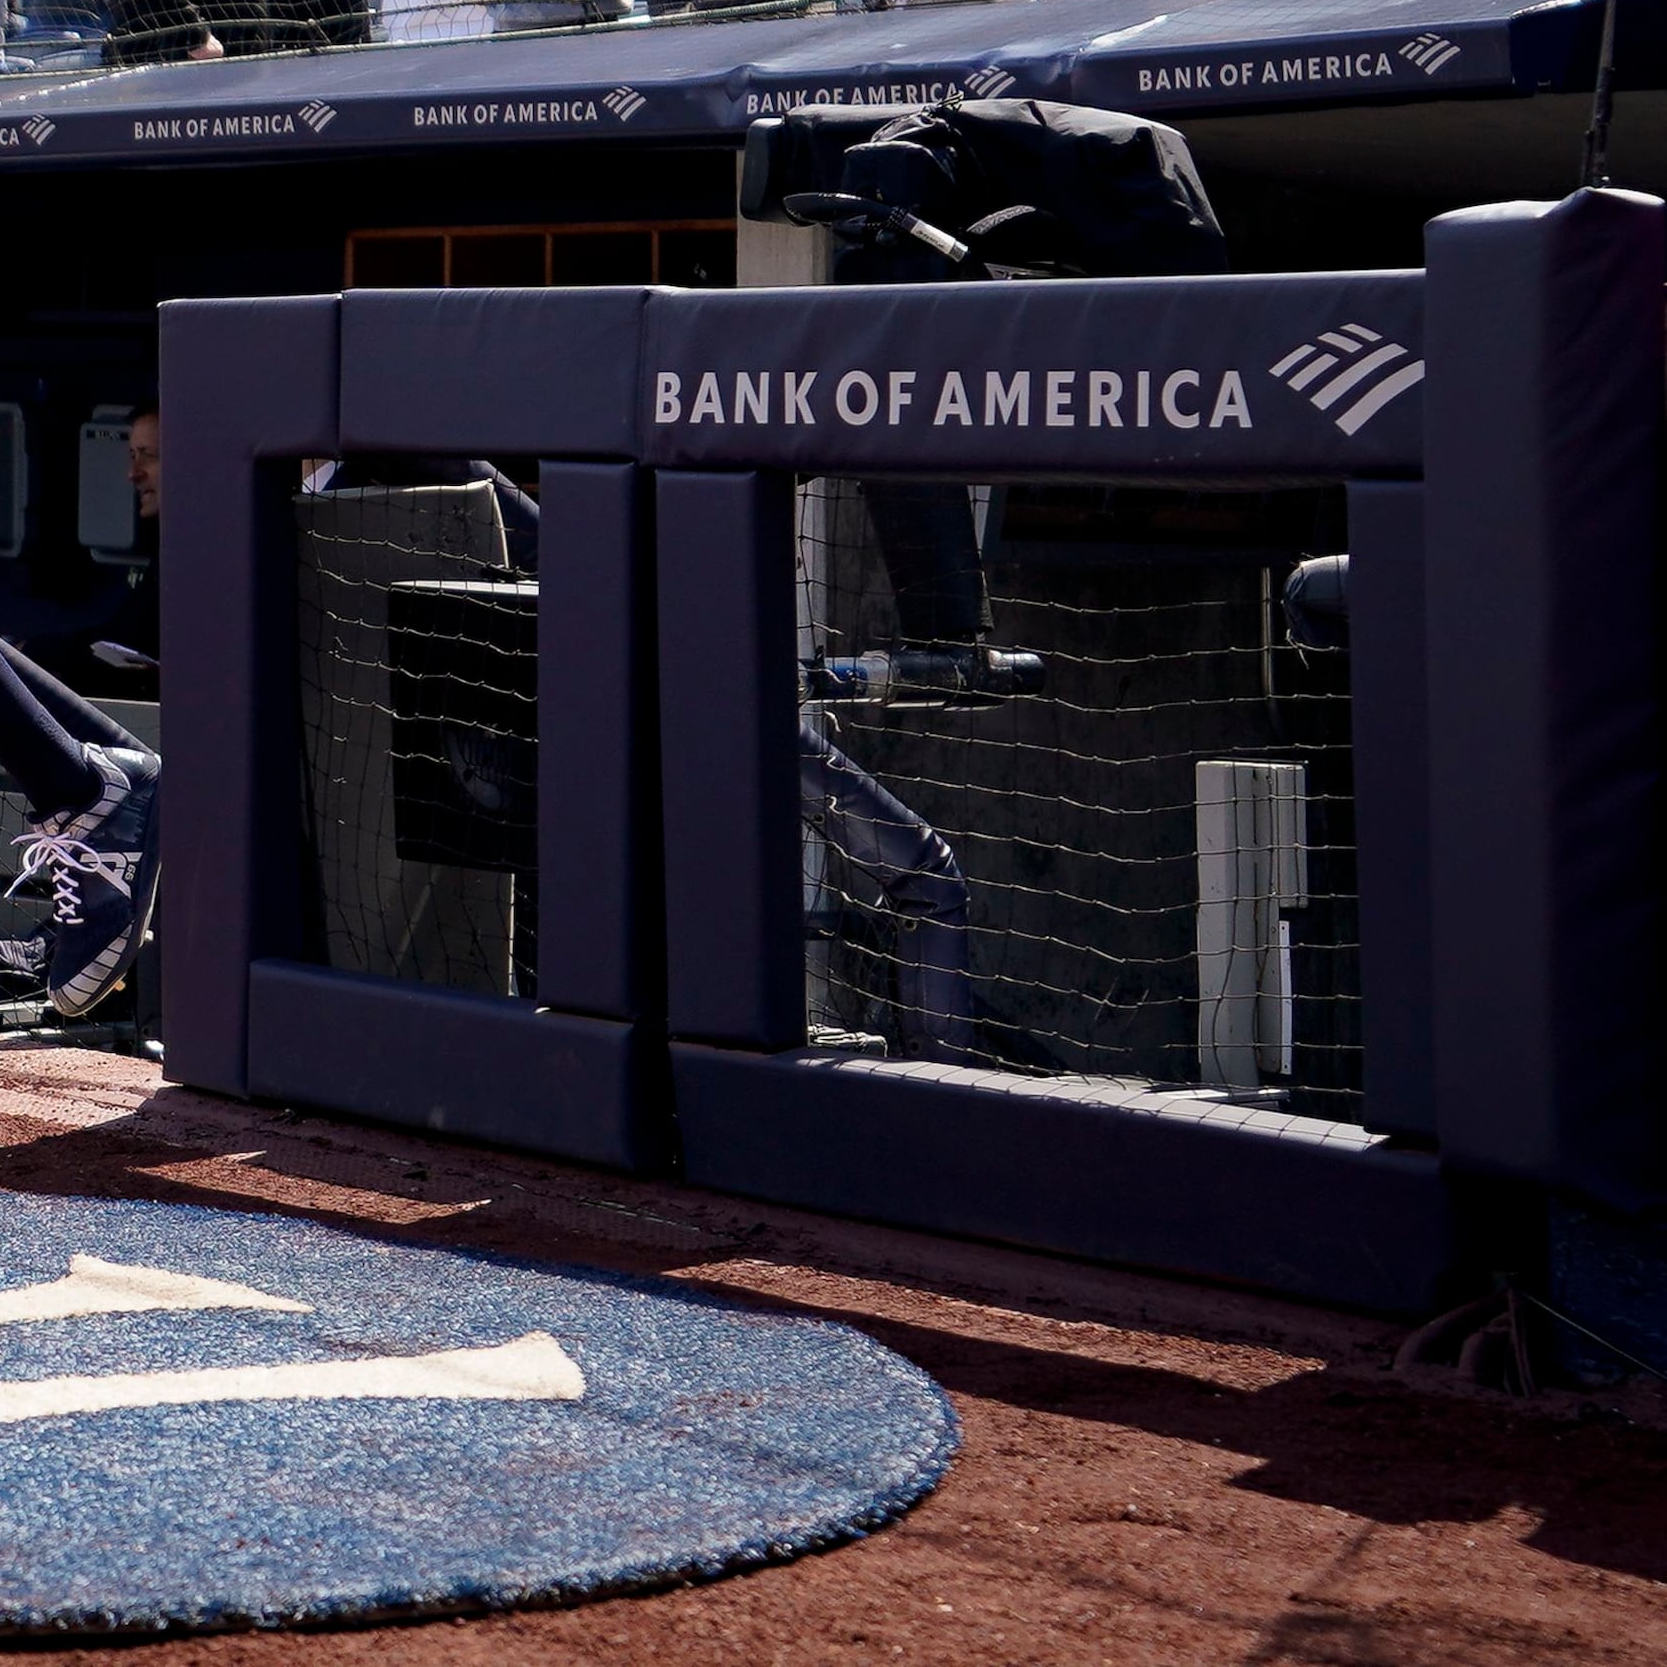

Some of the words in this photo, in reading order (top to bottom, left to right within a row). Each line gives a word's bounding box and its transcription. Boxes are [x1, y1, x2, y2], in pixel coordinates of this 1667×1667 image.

[1139, 65, 1212, 92] BANK
[1219, 62, 1254, 87] OF
[1262, 53, 1393, 84] AMERICA
[414, 106, 468, 127] BANK
[473, 104, 499, 124] OF
[503, 100, 598, 123] AMERICA
[747, 88, 808, 115] BANK
[818, 87, 842, 105] OF
[848, 81, 958, 105] AMERICA
[134, 120, 181, 140] BANK
[186, 118, 209, 137] OF
[212, 113, 295, 136] AMERICA
[653, 370, 819, 425] BANK
[835, 369, 917, 425] OF
[933, 368, 1252, 430] AMERICA
